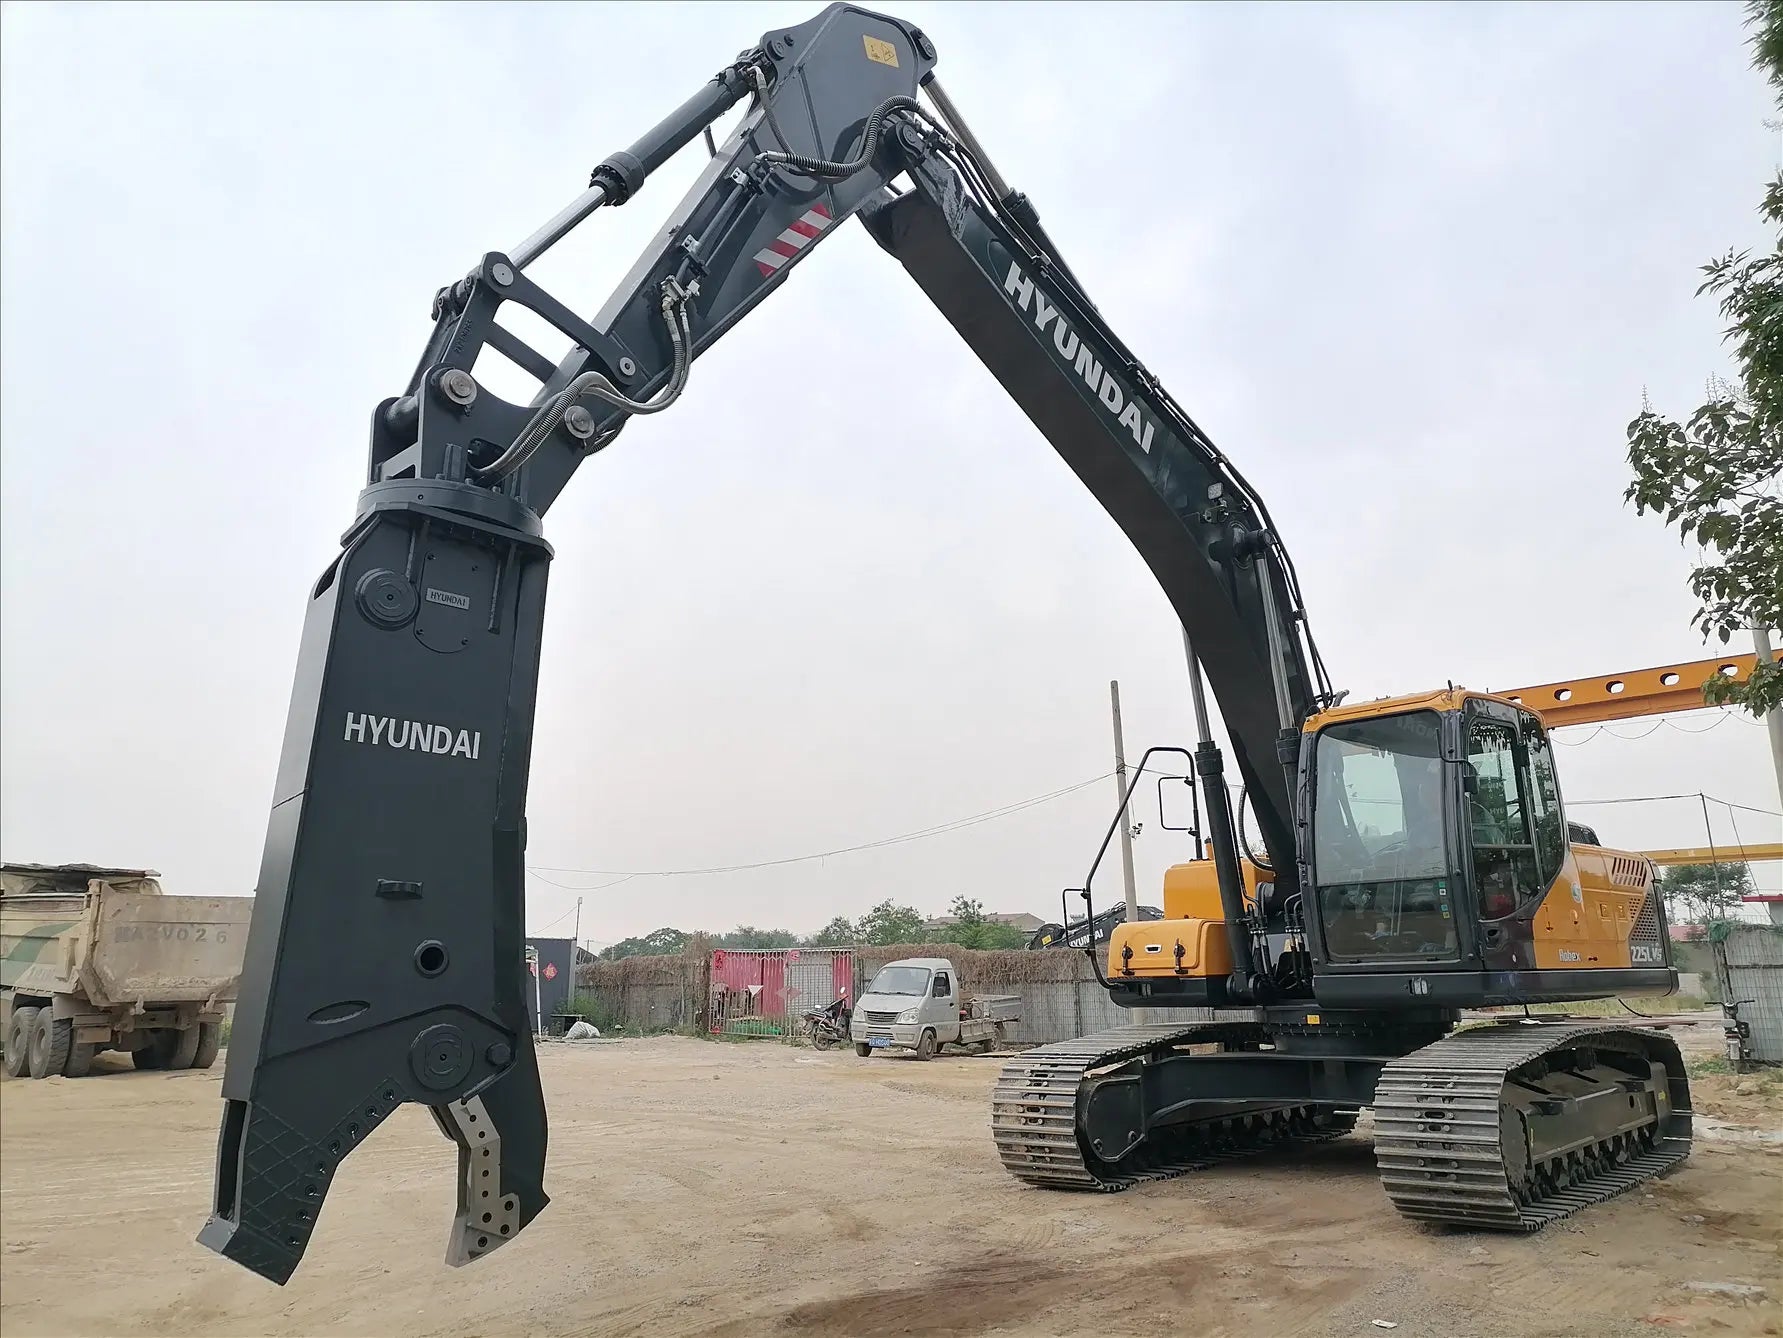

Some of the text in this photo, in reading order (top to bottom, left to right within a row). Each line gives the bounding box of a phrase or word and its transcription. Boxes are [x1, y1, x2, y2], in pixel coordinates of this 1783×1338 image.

[1004, 260, 1154, 454] HYUNDAI
[430, 590, 466, 607] HYUNDAI
[344, 711, 481, 760] HYUNDAI
